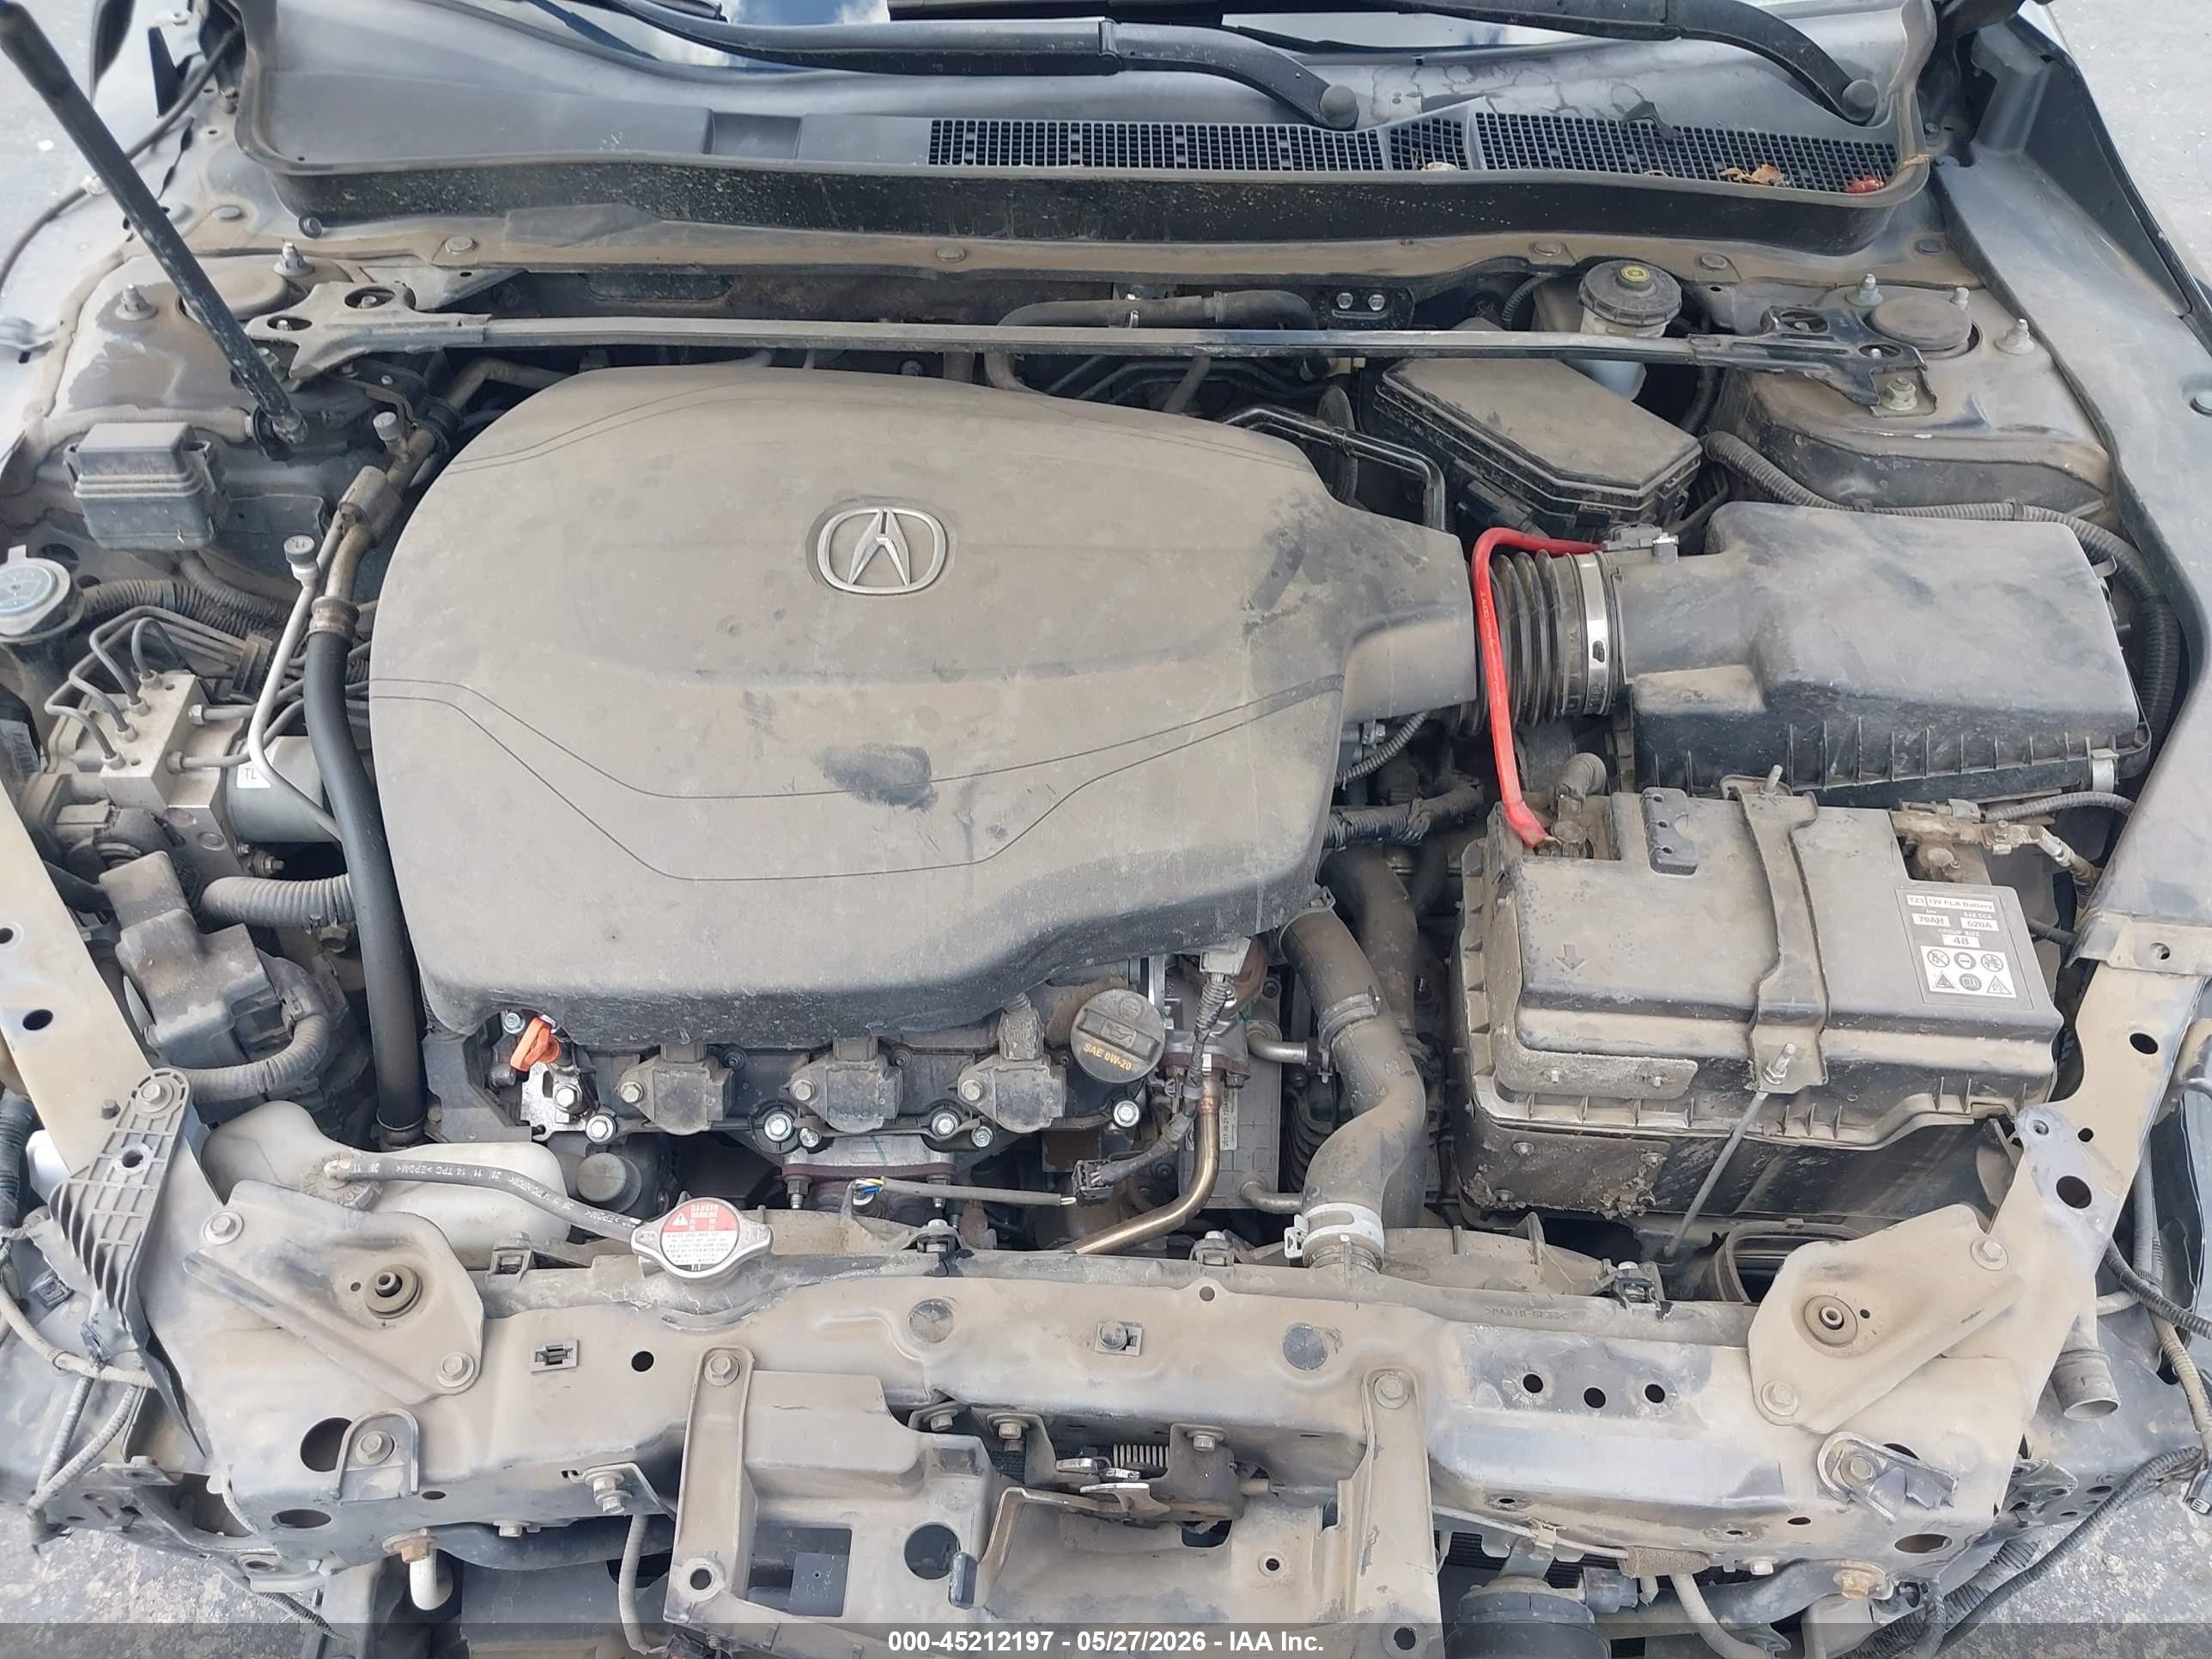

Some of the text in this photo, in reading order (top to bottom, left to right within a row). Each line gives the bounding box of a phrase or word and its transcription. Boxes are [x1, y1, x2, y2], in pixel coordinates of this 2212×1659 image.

[1962, 902, 1993, 910] Battery
[1953, 936, 1970, 945] 48
[1083, 1043, 1132, 1071] SAE 0W-20
